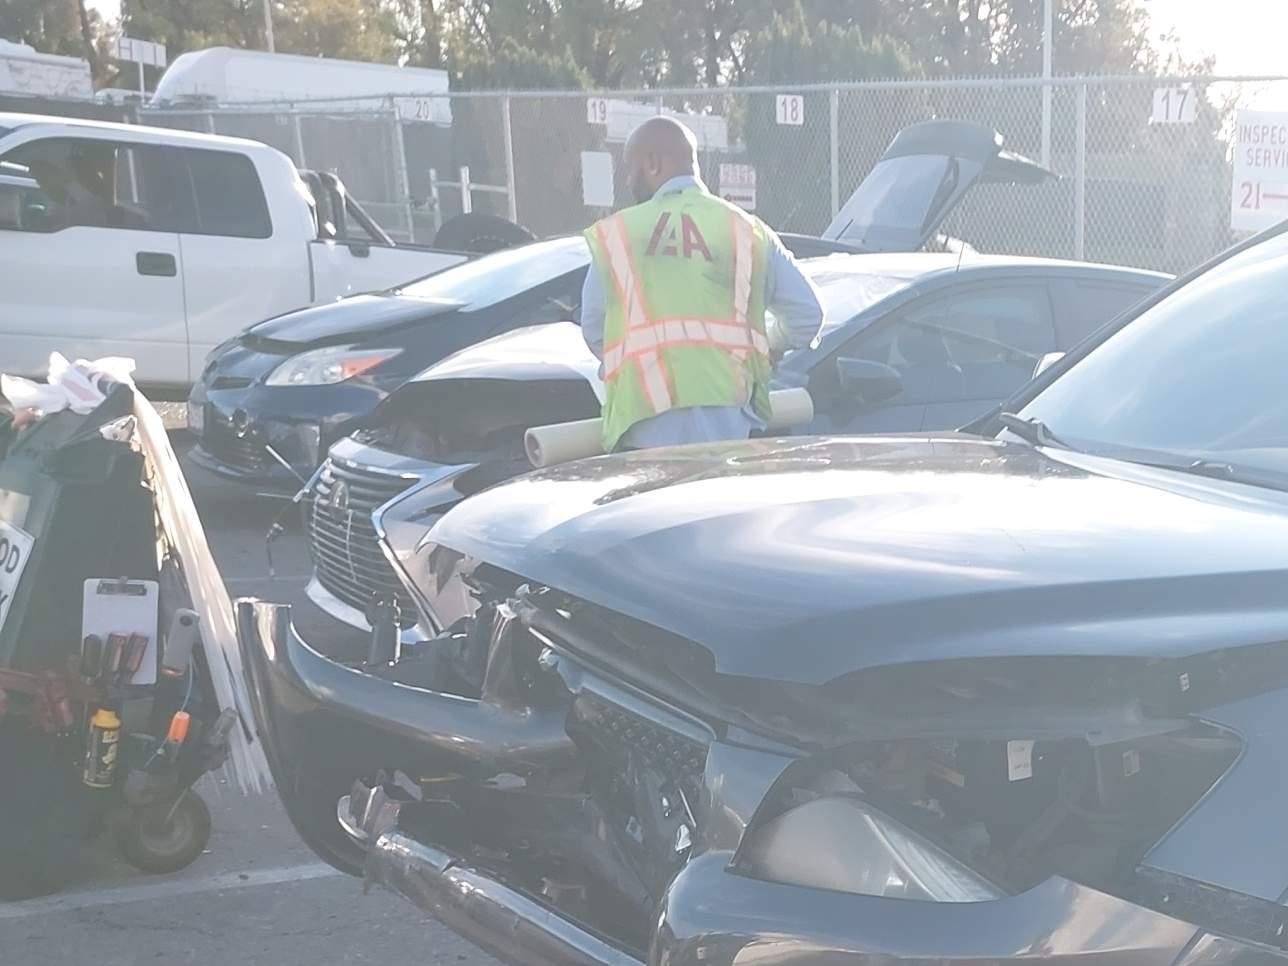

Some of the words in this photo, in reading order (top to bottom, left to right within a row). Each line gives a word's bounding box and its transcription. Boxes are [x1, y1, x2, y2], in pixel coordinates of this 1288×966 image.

[591, 100, 607, 121] 19
[782, 97, 799, 121] 18
[1161, 90, 1189, 120] 17
